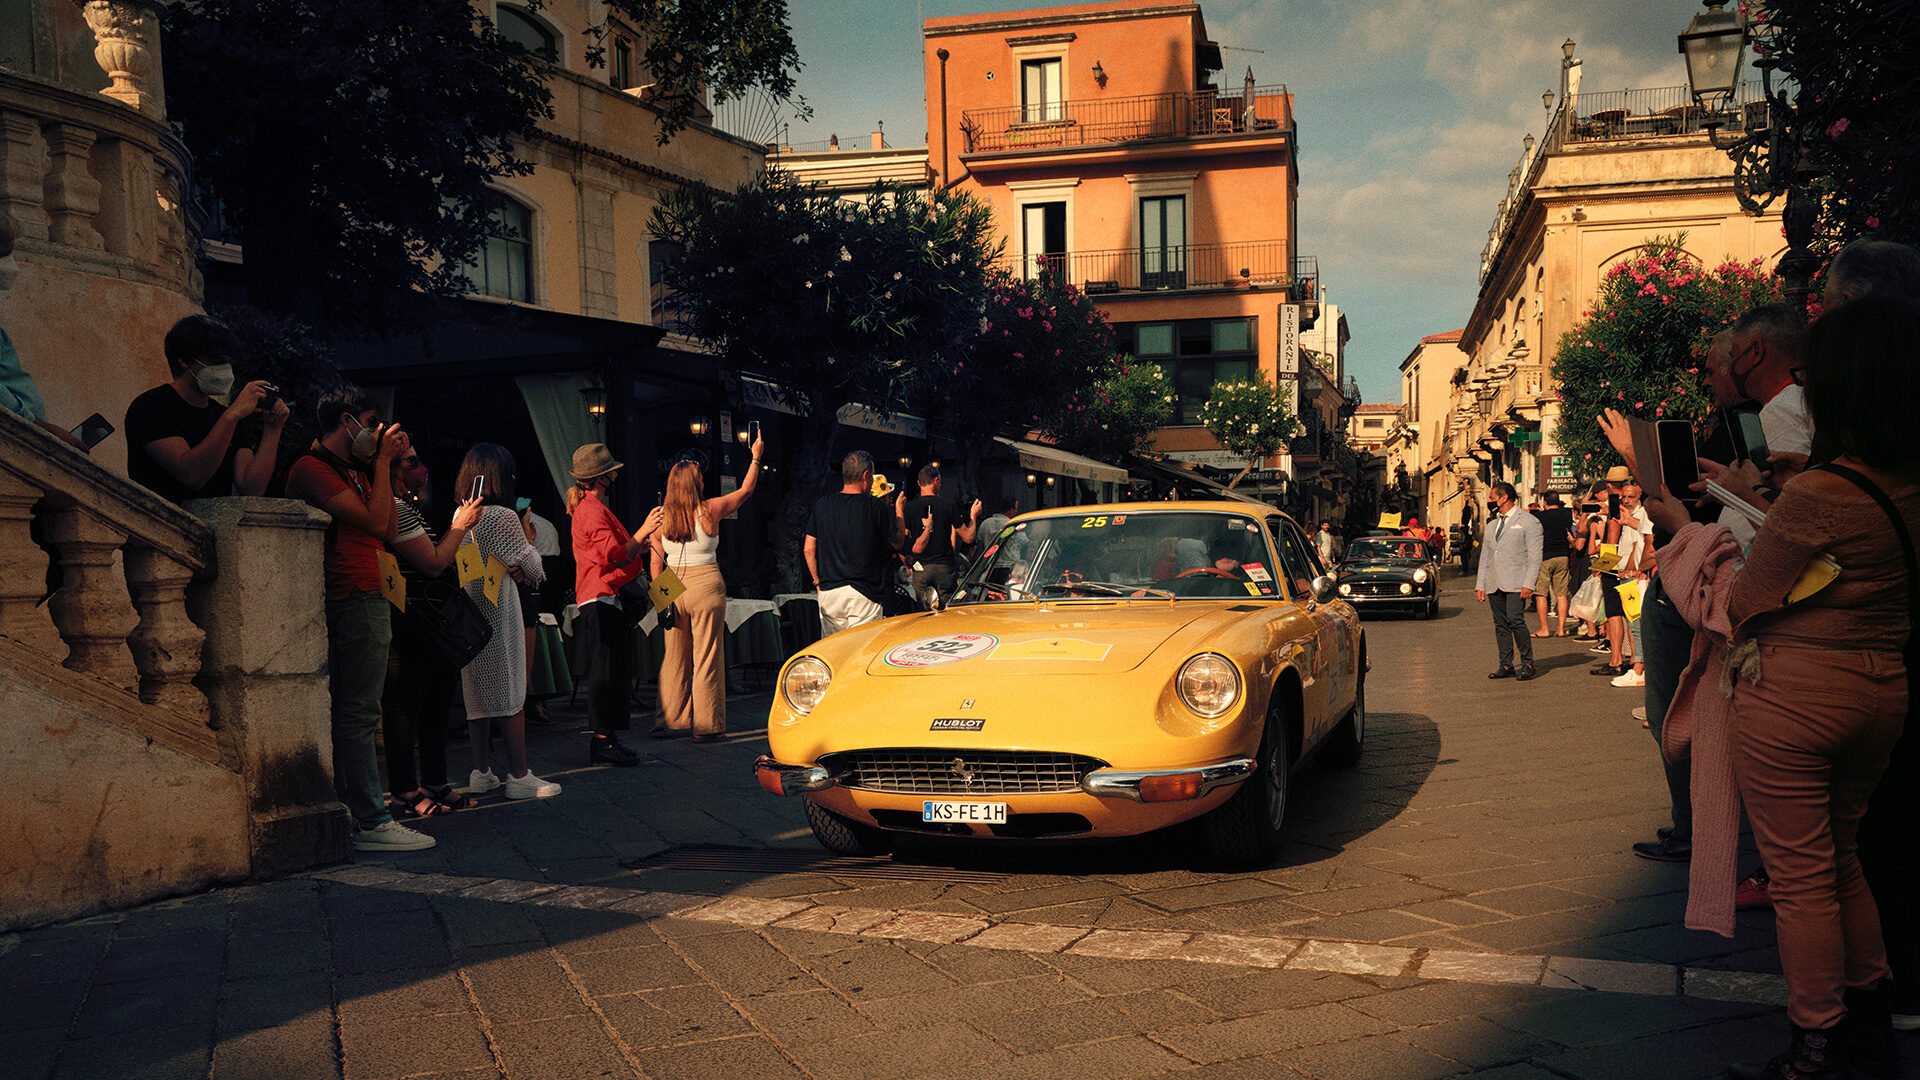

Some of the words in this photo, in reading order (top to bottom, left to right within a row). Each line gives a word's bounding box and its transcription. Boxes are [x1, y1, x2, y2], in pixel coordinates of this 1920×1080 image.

[1285, 306, 1294, 371] RISTORANTE
[1081, 516, 1109, 528] 25
[916, 640, 973, 654] 522
[933, 719, 983, 727] HUBLOT
[934, 804, 979, 820] KS-FE
[983, 805, 1004, 820] 1H
